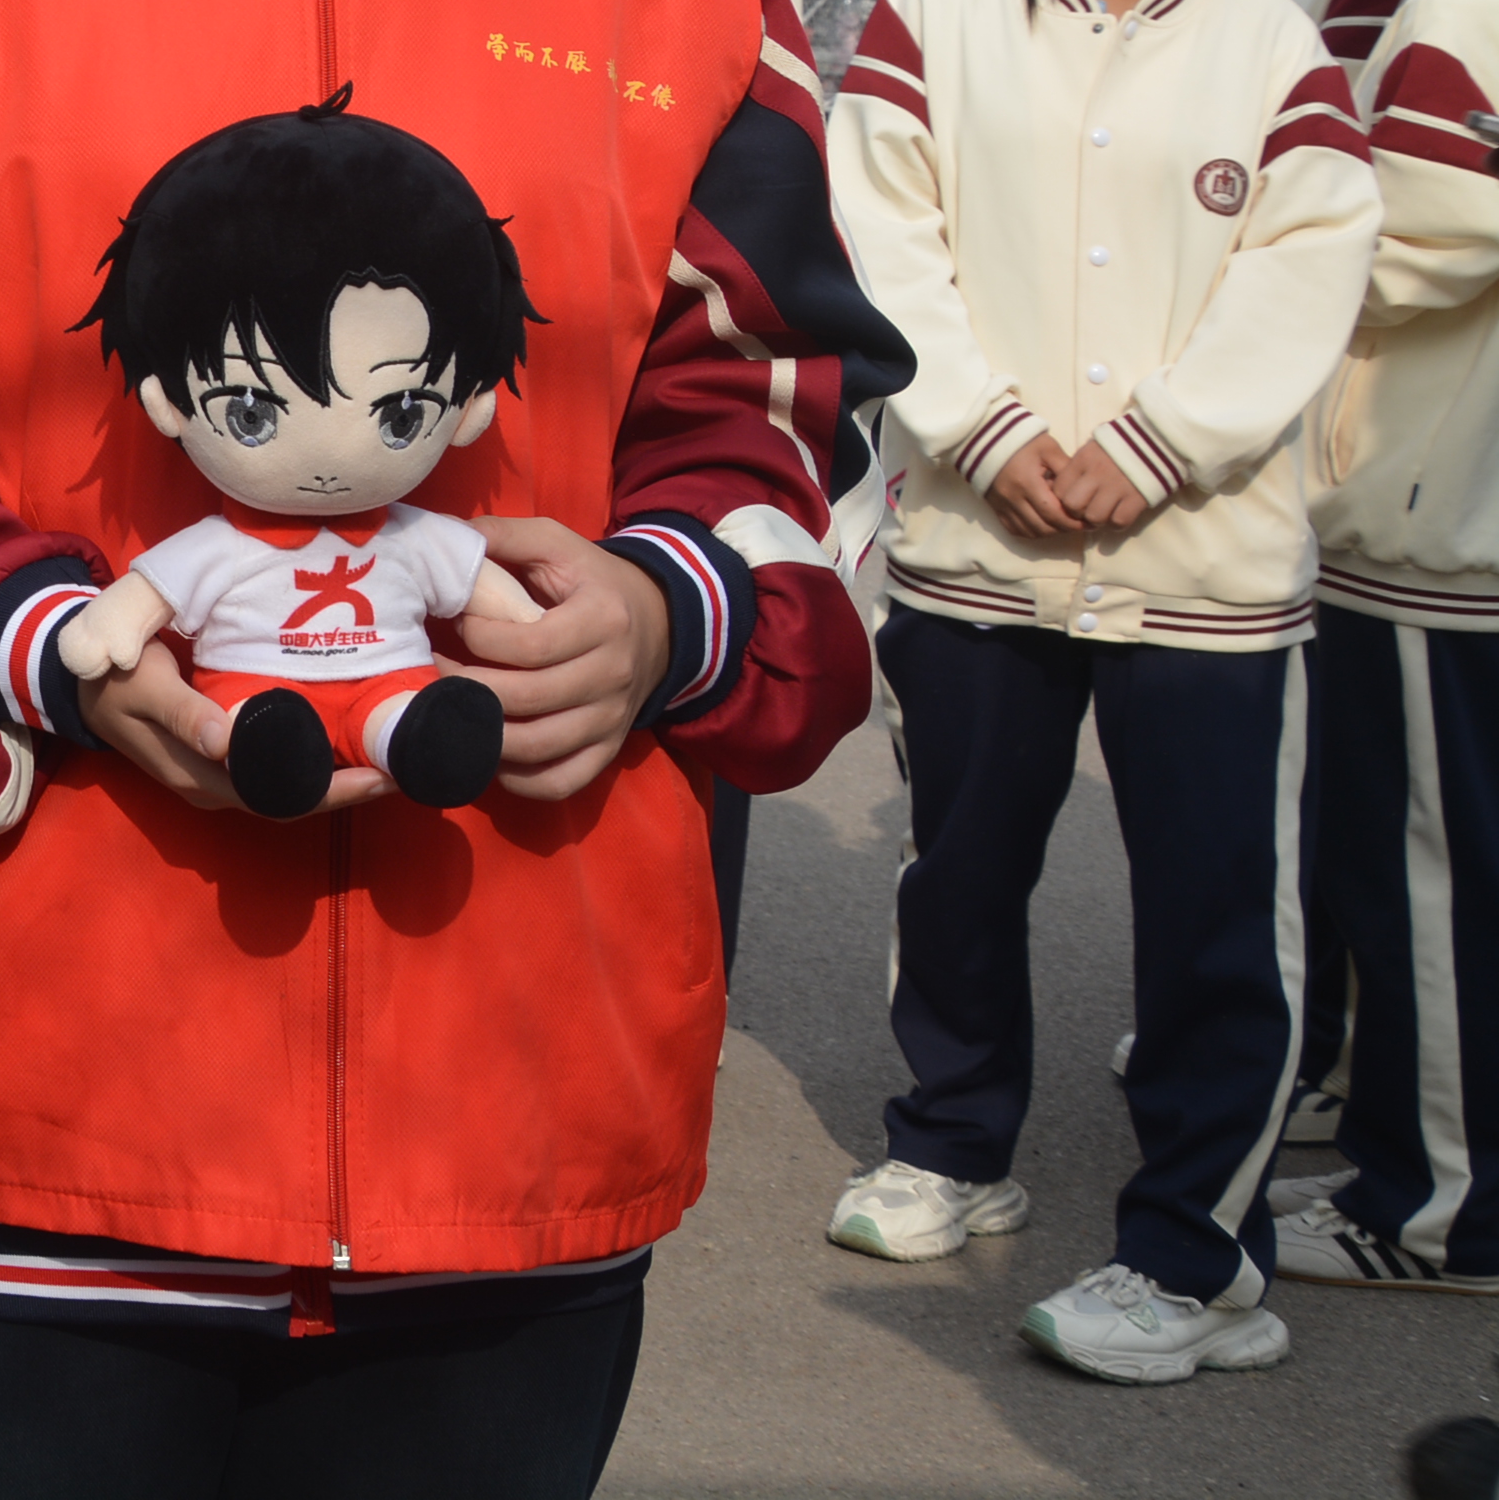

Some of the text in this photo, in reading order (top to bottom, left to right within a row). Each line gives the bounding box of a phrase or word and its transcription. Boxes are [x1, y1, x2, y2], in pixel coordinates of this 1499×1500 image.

[279, 627, 385, 648] 中国大学生在线
